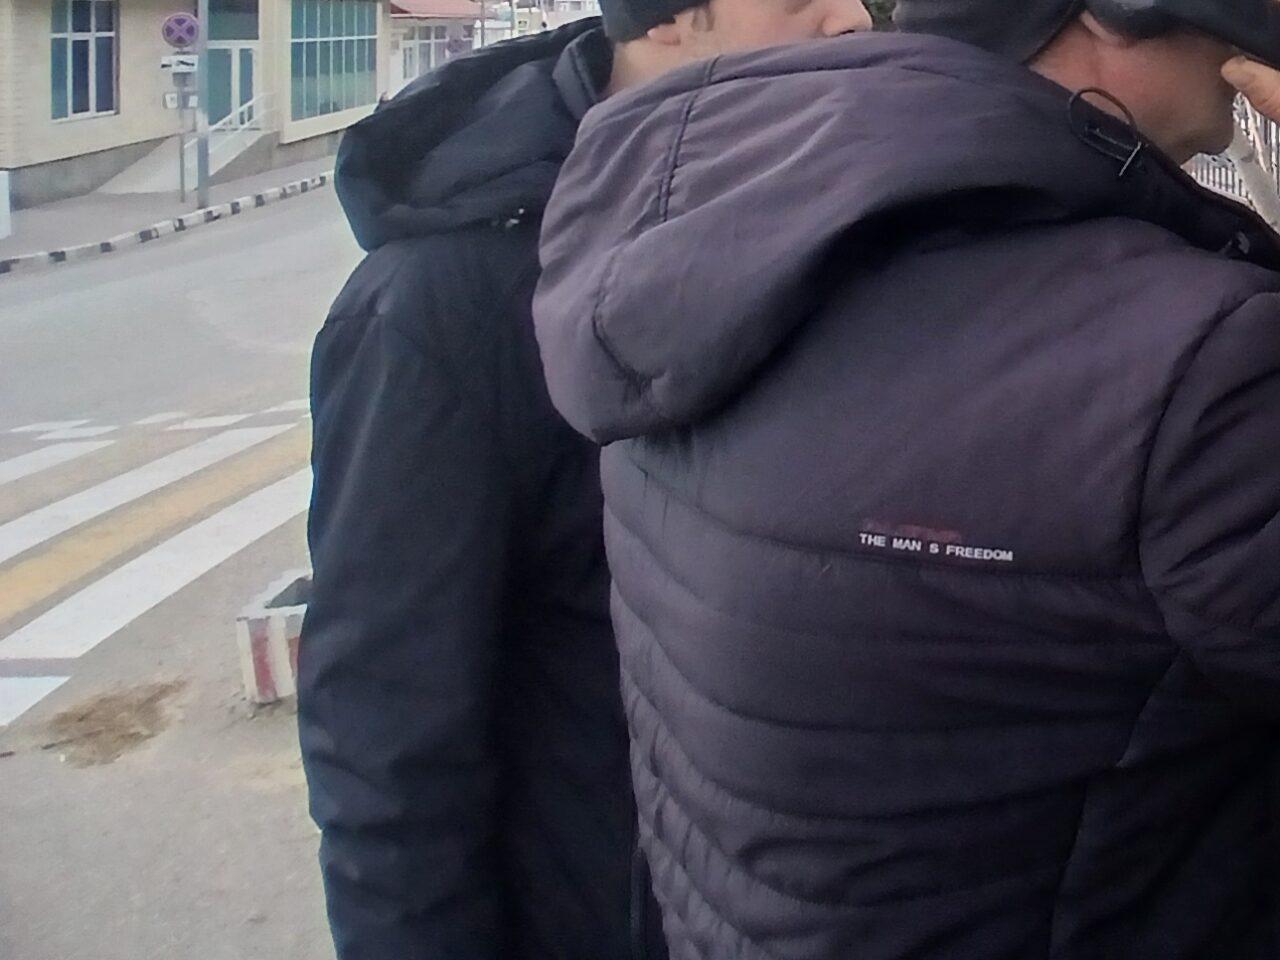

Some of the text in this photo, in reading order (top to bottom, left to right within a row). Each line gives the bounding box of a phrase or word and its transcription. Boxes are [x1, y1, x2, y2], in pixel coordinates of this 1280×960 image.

[859, 533, 886, 547] THE
[892, 538, 922, 552] MAN
[945, 545, 1014, 561] FREEDOM
